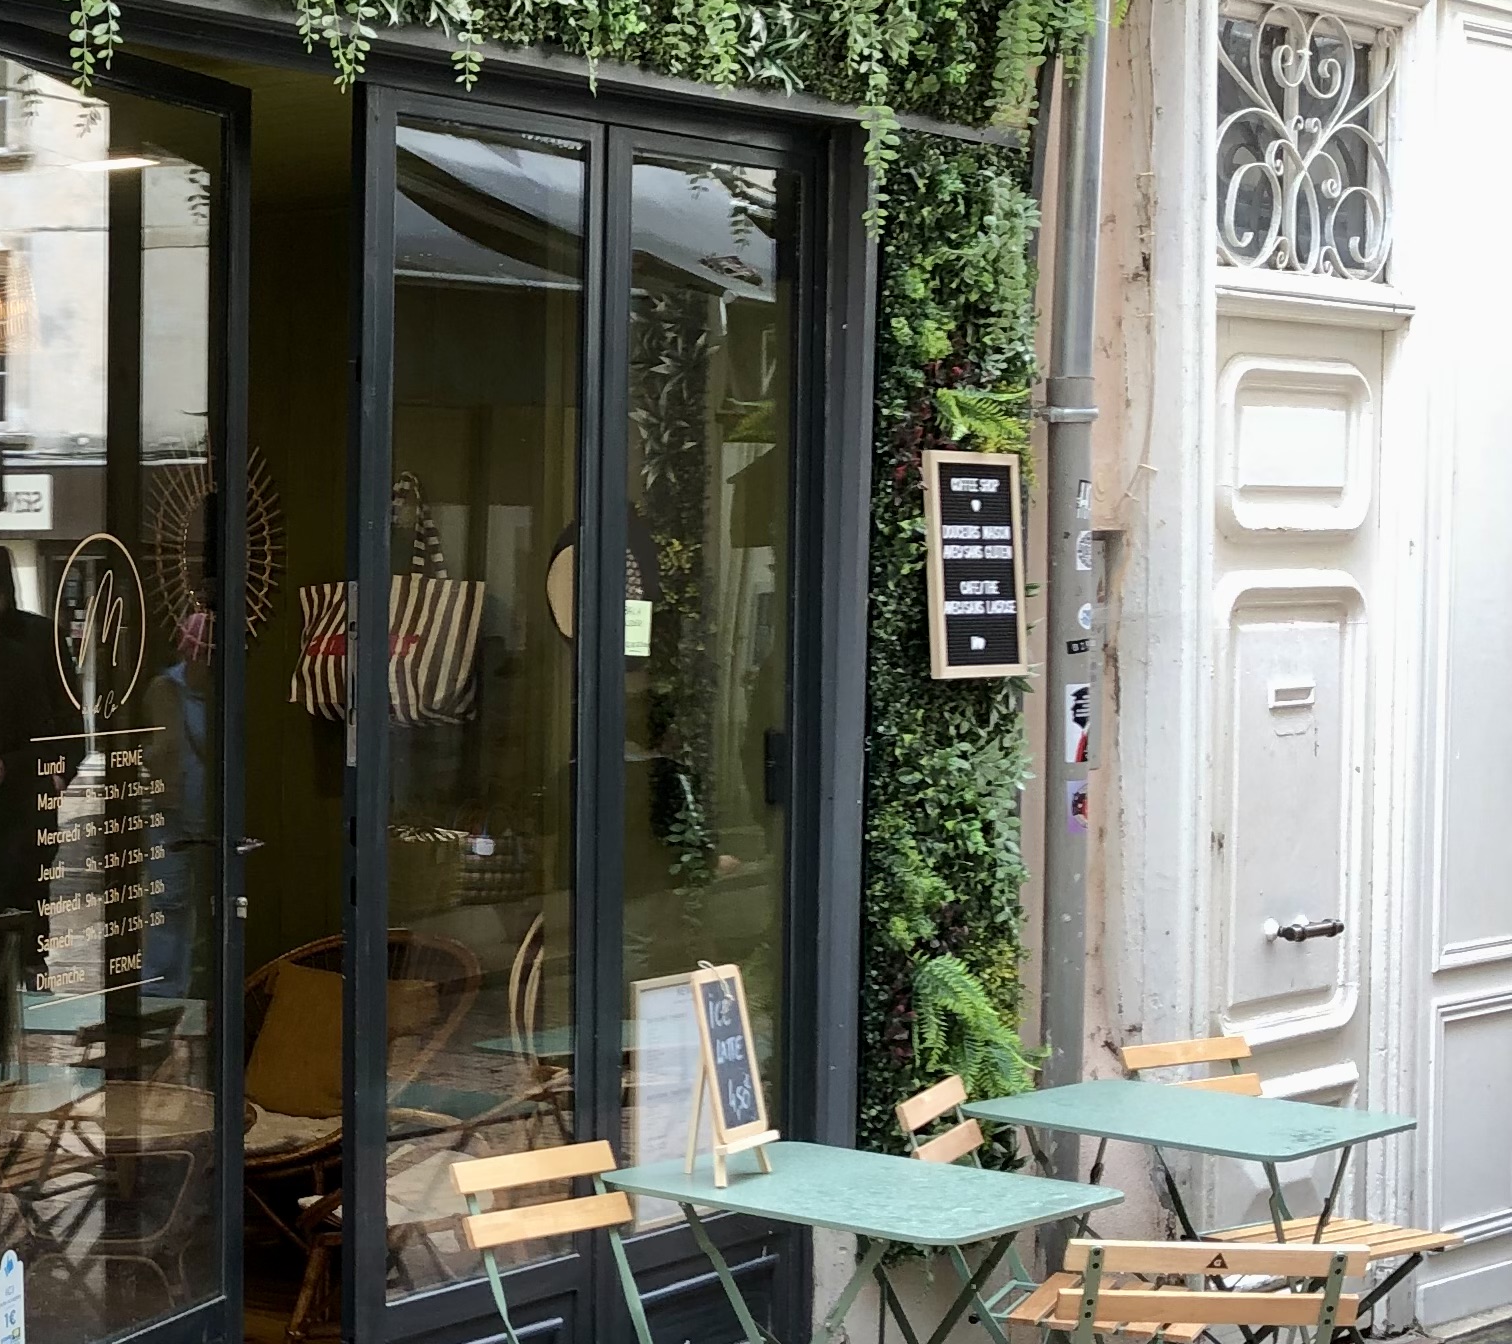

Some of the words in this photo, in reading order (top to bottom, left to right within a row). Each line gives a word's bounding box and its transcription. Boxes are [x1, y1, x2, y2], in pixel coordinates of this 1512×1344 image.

[37, 755, 66, 776] Lundi
[110, 744, 144, 769] FERMÉ
[37, 791, 64, 811] Mard
[36, 822, 81, 847] Mercredi
[37, 860, 65, 882] Jeudi
[37, 892, 81, 917] Vendredi
[36, 928, 73, 953] Samedi
[36, 965, 85, 991] Dimanche
[109, 948, 143, 976] FERMÉ
[4, 1309, 17, 1328] 1€
